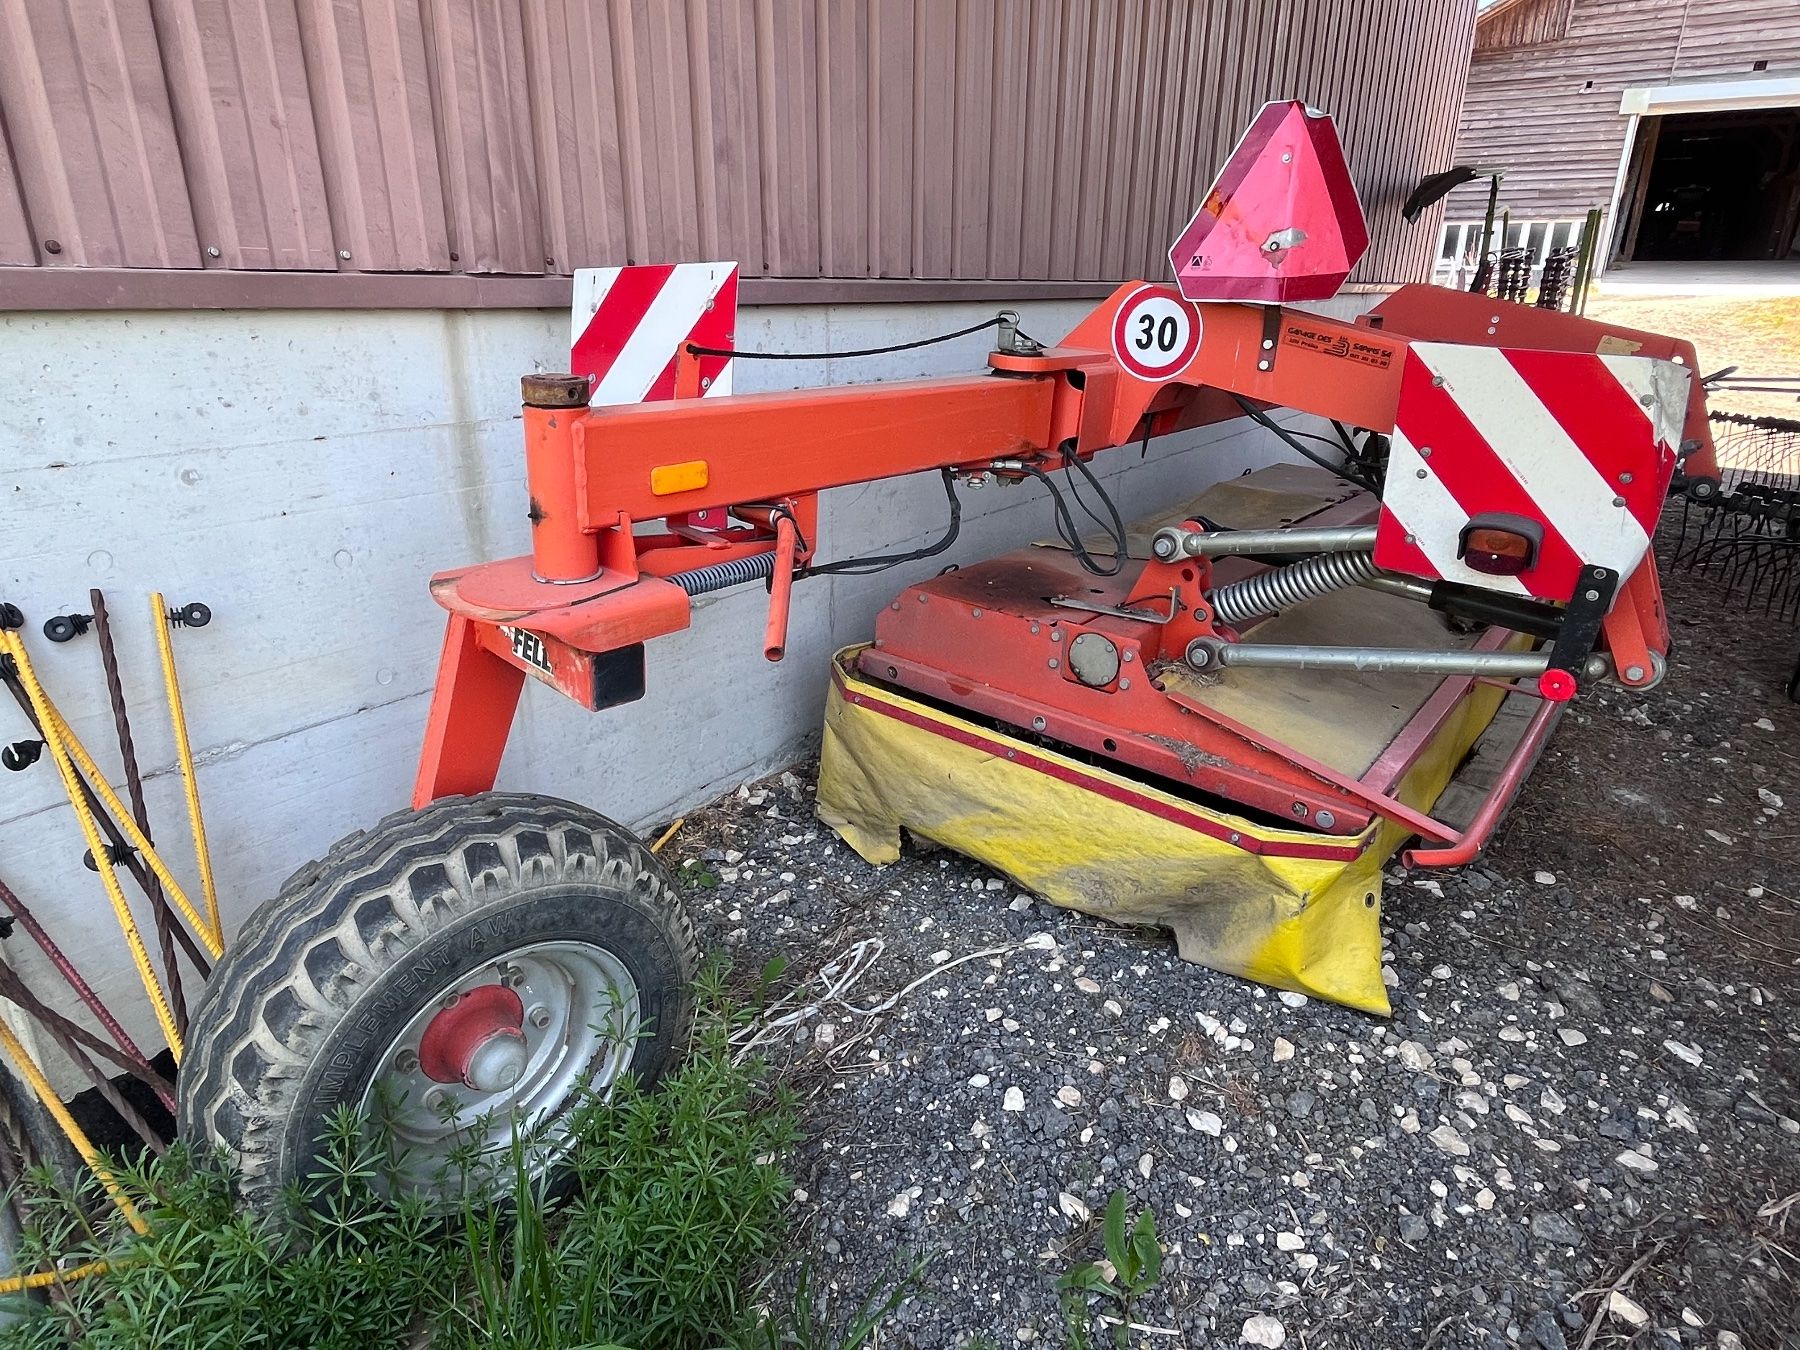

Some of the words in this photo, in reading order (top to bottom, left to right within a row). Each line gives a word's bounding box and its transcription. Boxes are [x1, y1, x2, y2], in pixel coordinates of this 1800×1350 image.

[1135, 313, 1178, 352] 30
[1317, 334, 1333, 343] DES
[313, 944, 451, 1104] IMPLEMENT
[469, 911, 513, 949] AW
